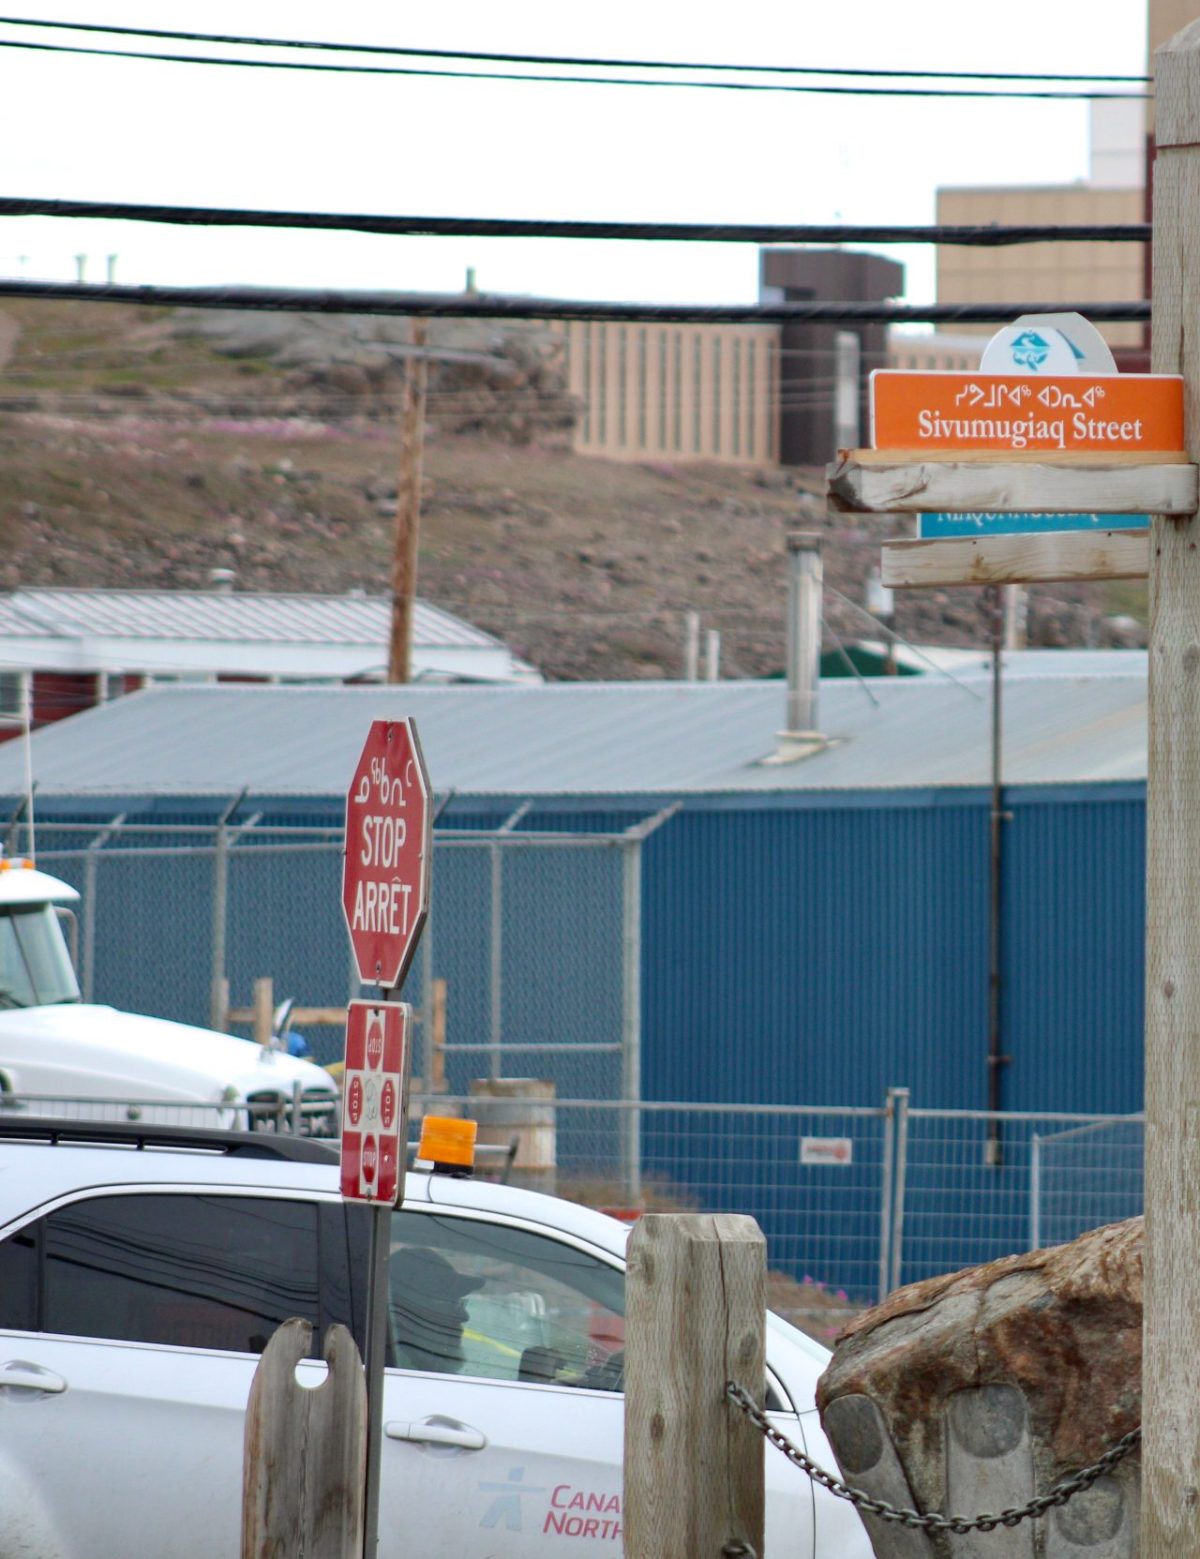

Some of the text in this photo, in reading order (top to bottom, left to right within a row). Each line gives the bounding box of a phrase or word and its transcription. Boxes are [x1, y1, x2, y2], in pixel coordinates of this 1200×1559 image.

[918, 409, 1143, 449] Sivumugiaq Street
[360, 814, 407, 868] STOP
[352, 876, 412, 935] ARRÊT
[352, 1080, 360, 1123] STOP
[362, 1151, 378, 1167] STOP
